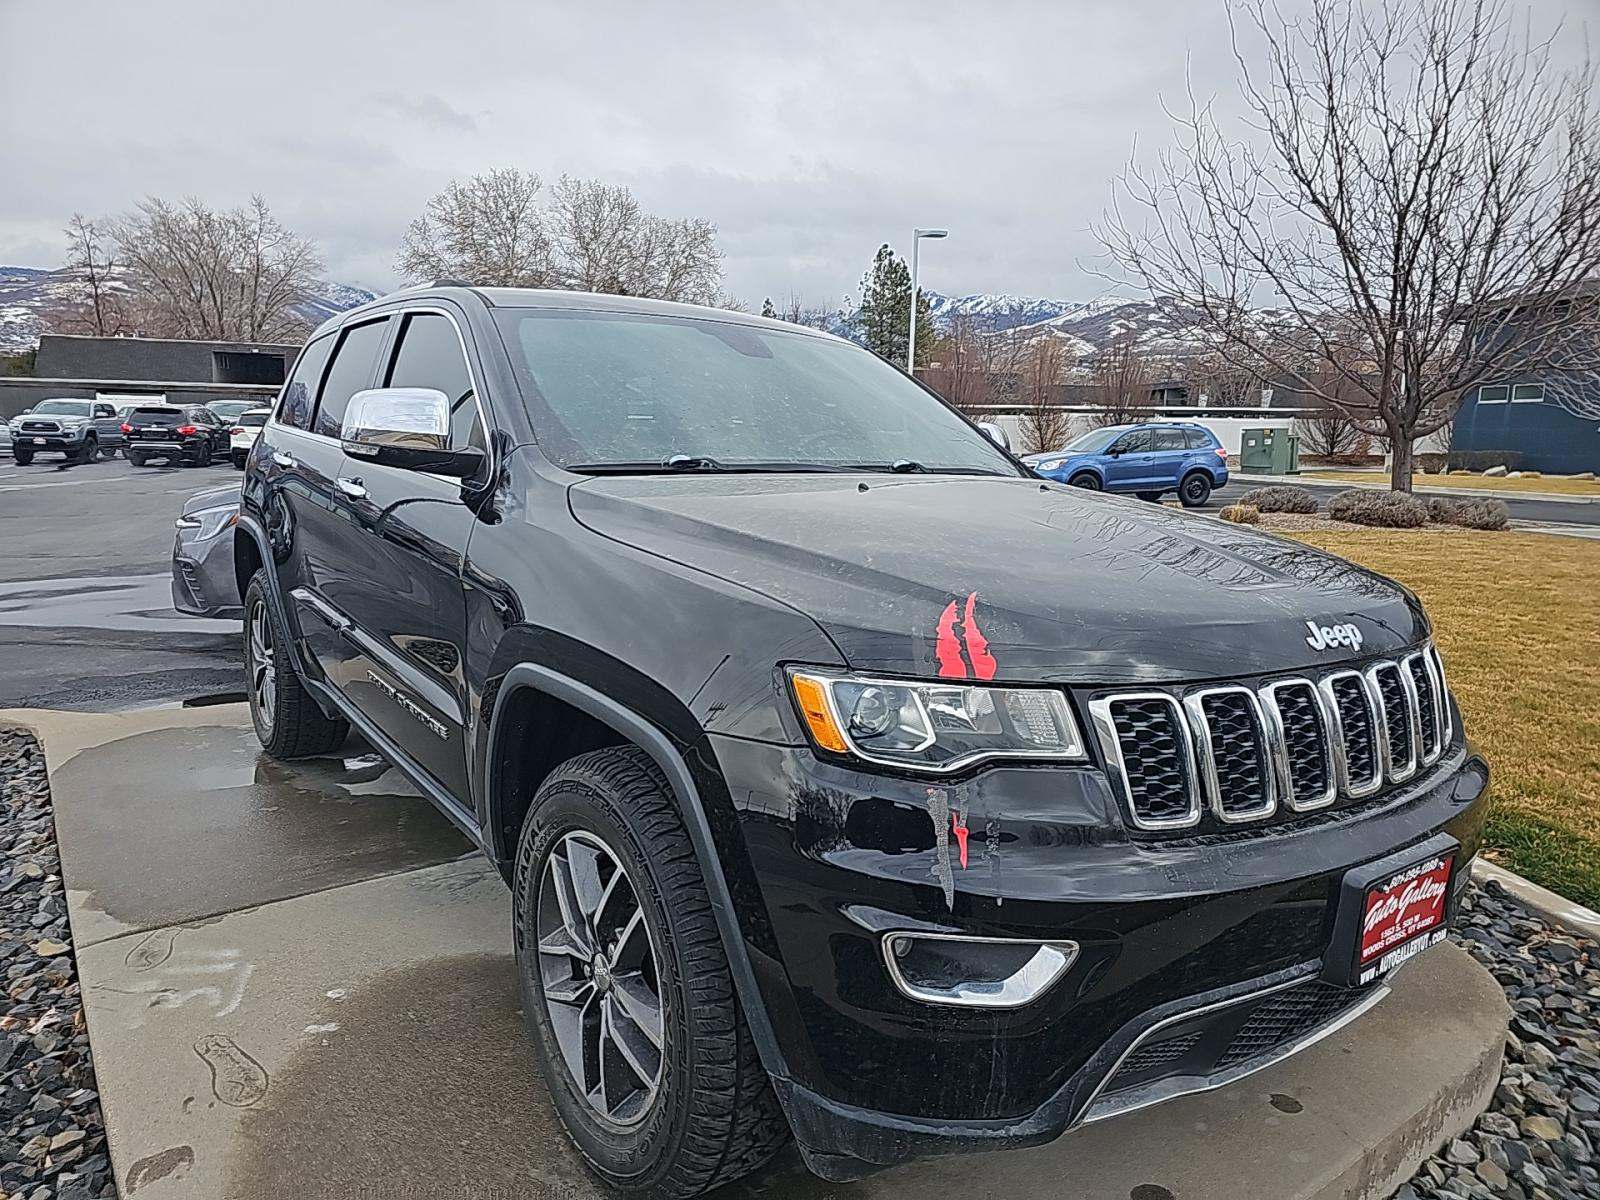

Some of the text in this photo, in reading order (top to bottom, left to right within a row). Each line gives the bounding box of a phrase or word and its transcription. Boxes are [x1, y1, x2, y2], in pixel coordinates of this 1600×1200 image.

[1305, 620, 1363, 652] Jeep
[1363, 876, 1447, 936] Auto Gallery
[1362, 940, 1385, 958] WOODS
